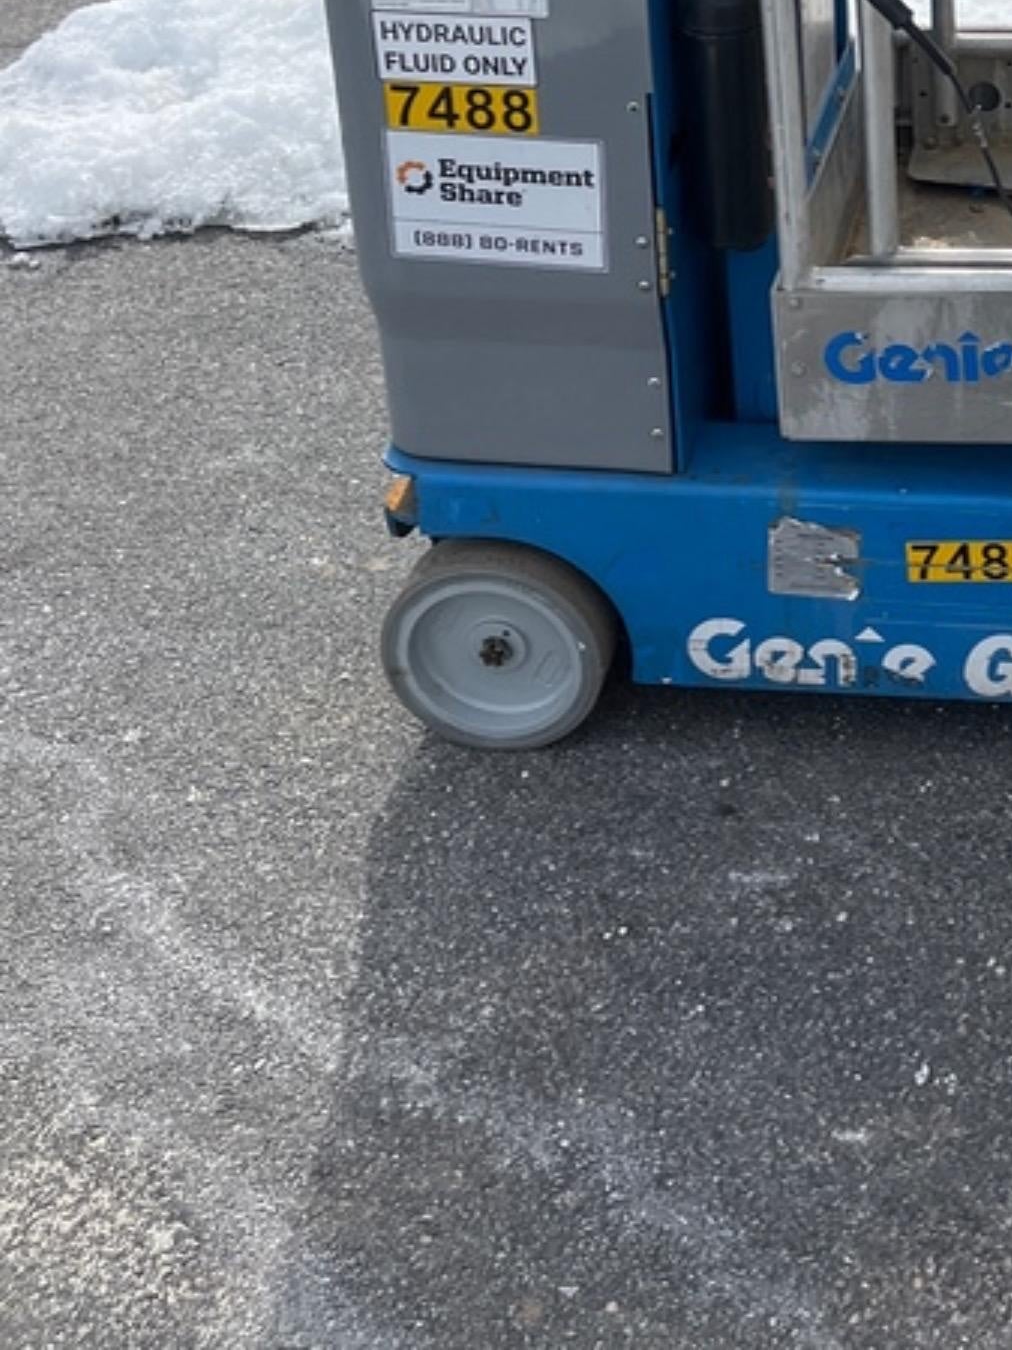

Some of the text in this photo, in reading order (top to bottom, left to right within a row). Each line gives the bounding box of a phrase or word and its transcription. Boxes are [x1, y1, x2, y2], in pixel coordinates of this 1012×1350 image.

[379, 21, 527, 47] HYDRAULIC
[385, 51, 528, 77] FLUID ONLY
[389, 84, 533, 133] 7488
[438, 158, 595, 189] Equipment
[440, 183, 523, 207] Share
[413, 230, 472, 249] (888)
[687, 617, 936, 687] Gene
